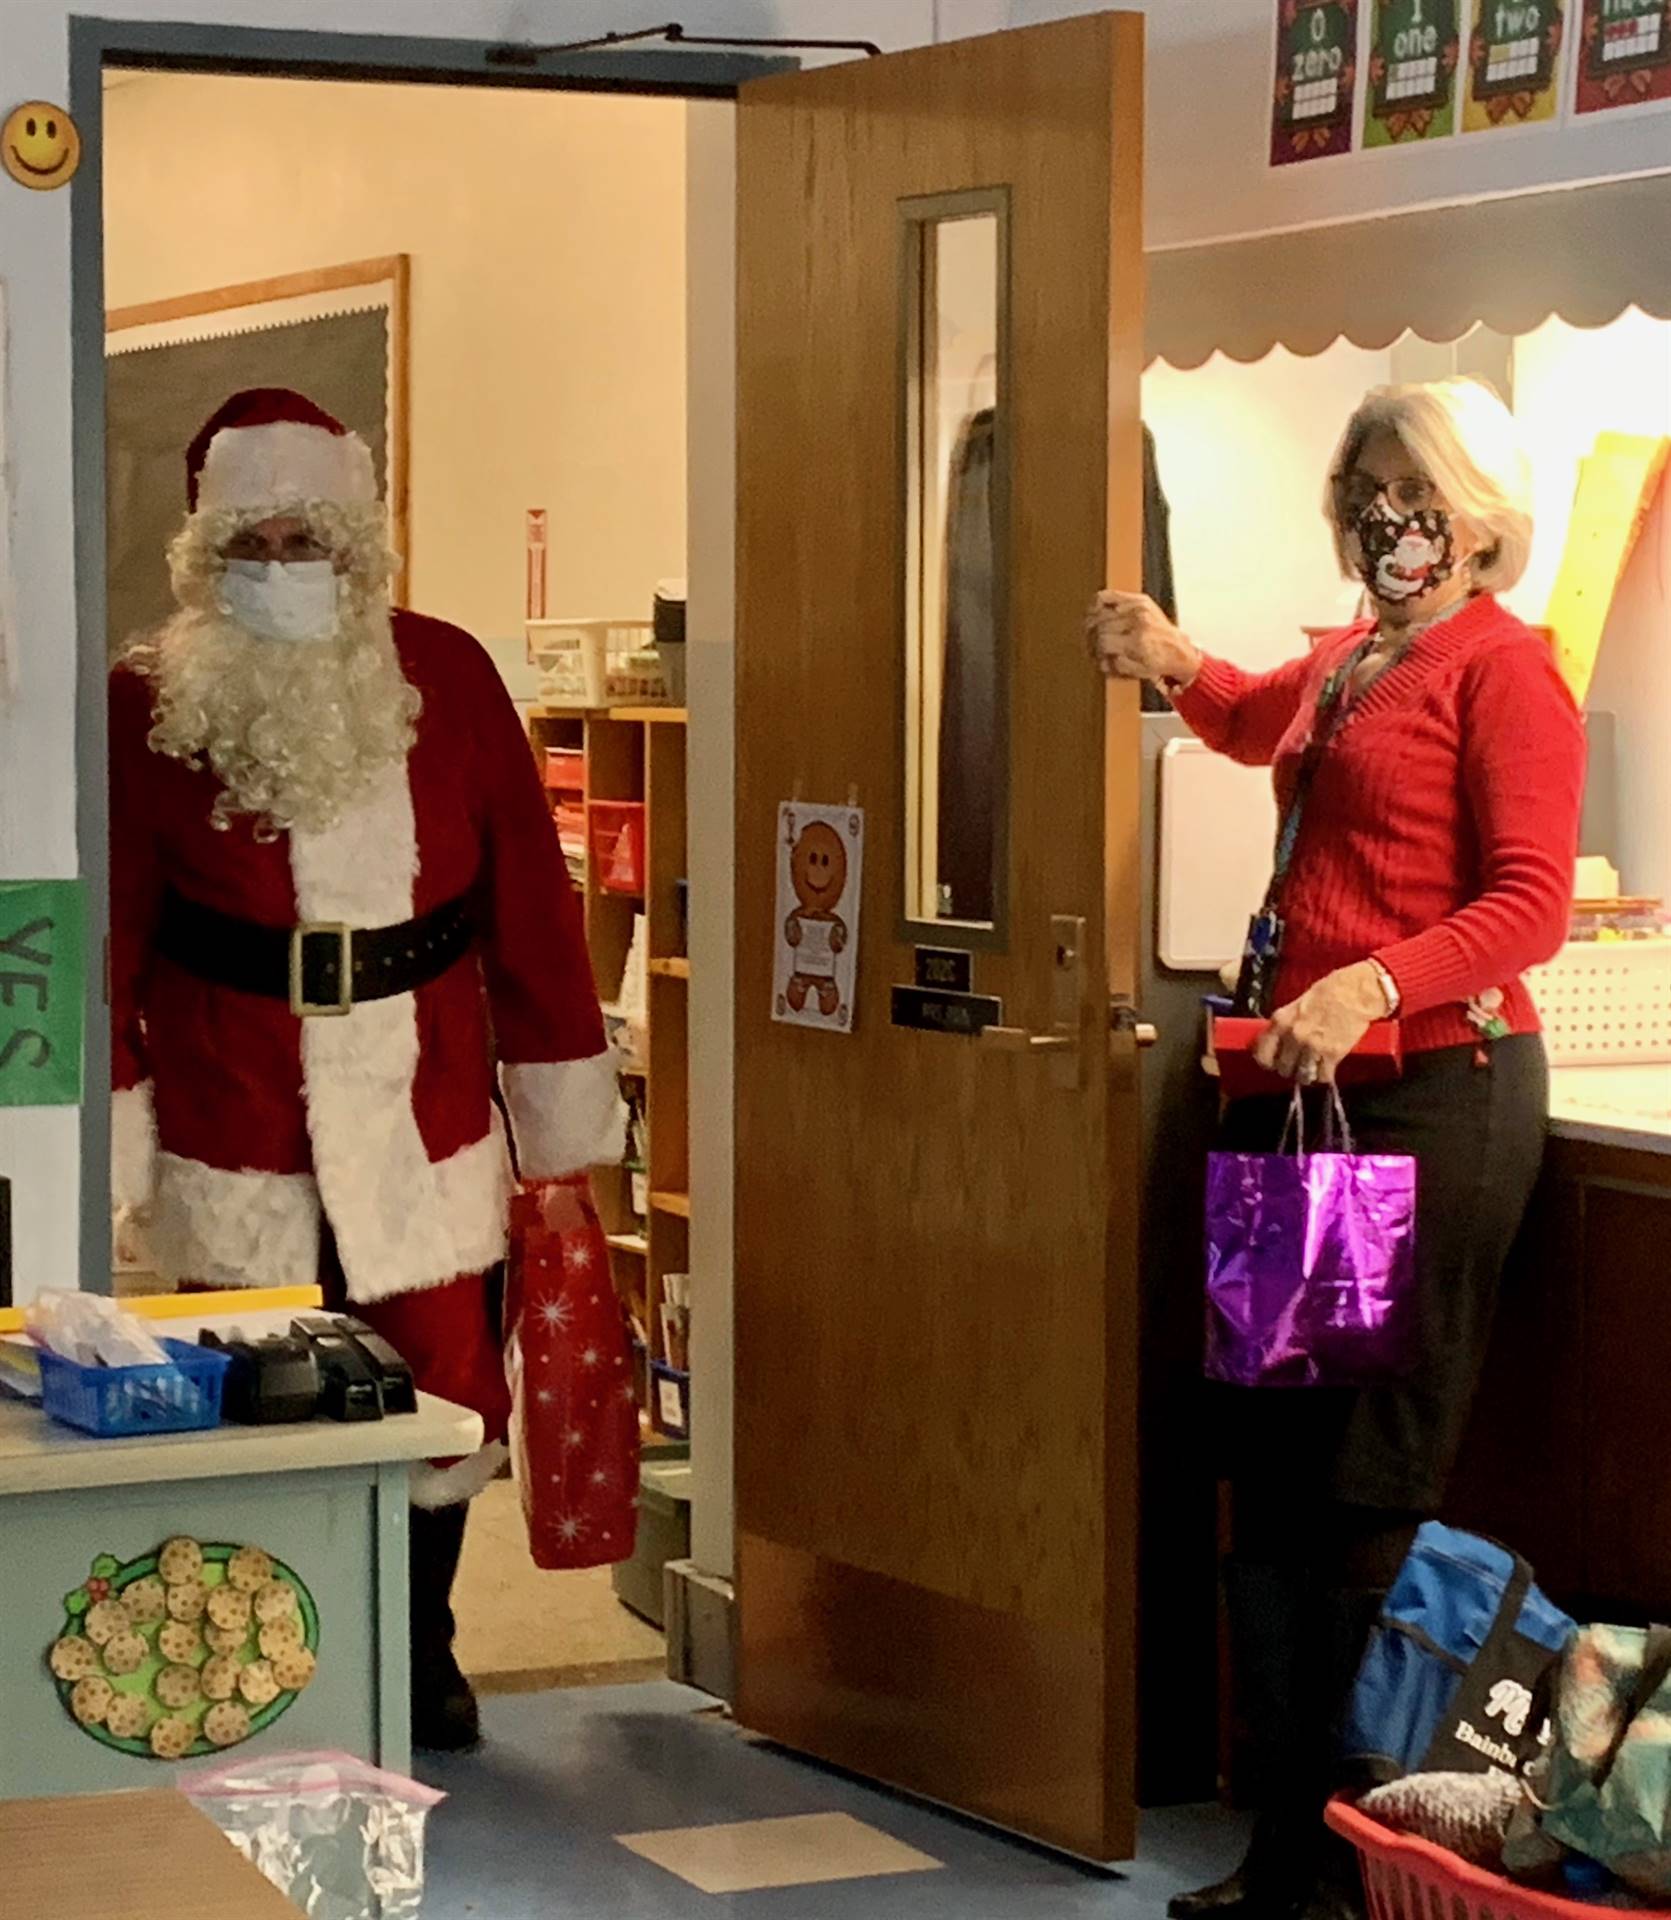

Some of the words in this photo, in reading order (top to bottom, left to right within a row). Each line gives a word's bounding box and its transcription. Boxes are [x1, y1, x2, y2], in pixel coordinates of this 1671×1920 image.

[1310, 8, 1326, 41] 0
[1495, 5, 1540, 38] two
[1394, 26, 1438, 59] one
[1291, 46, 1342, 81] zero
